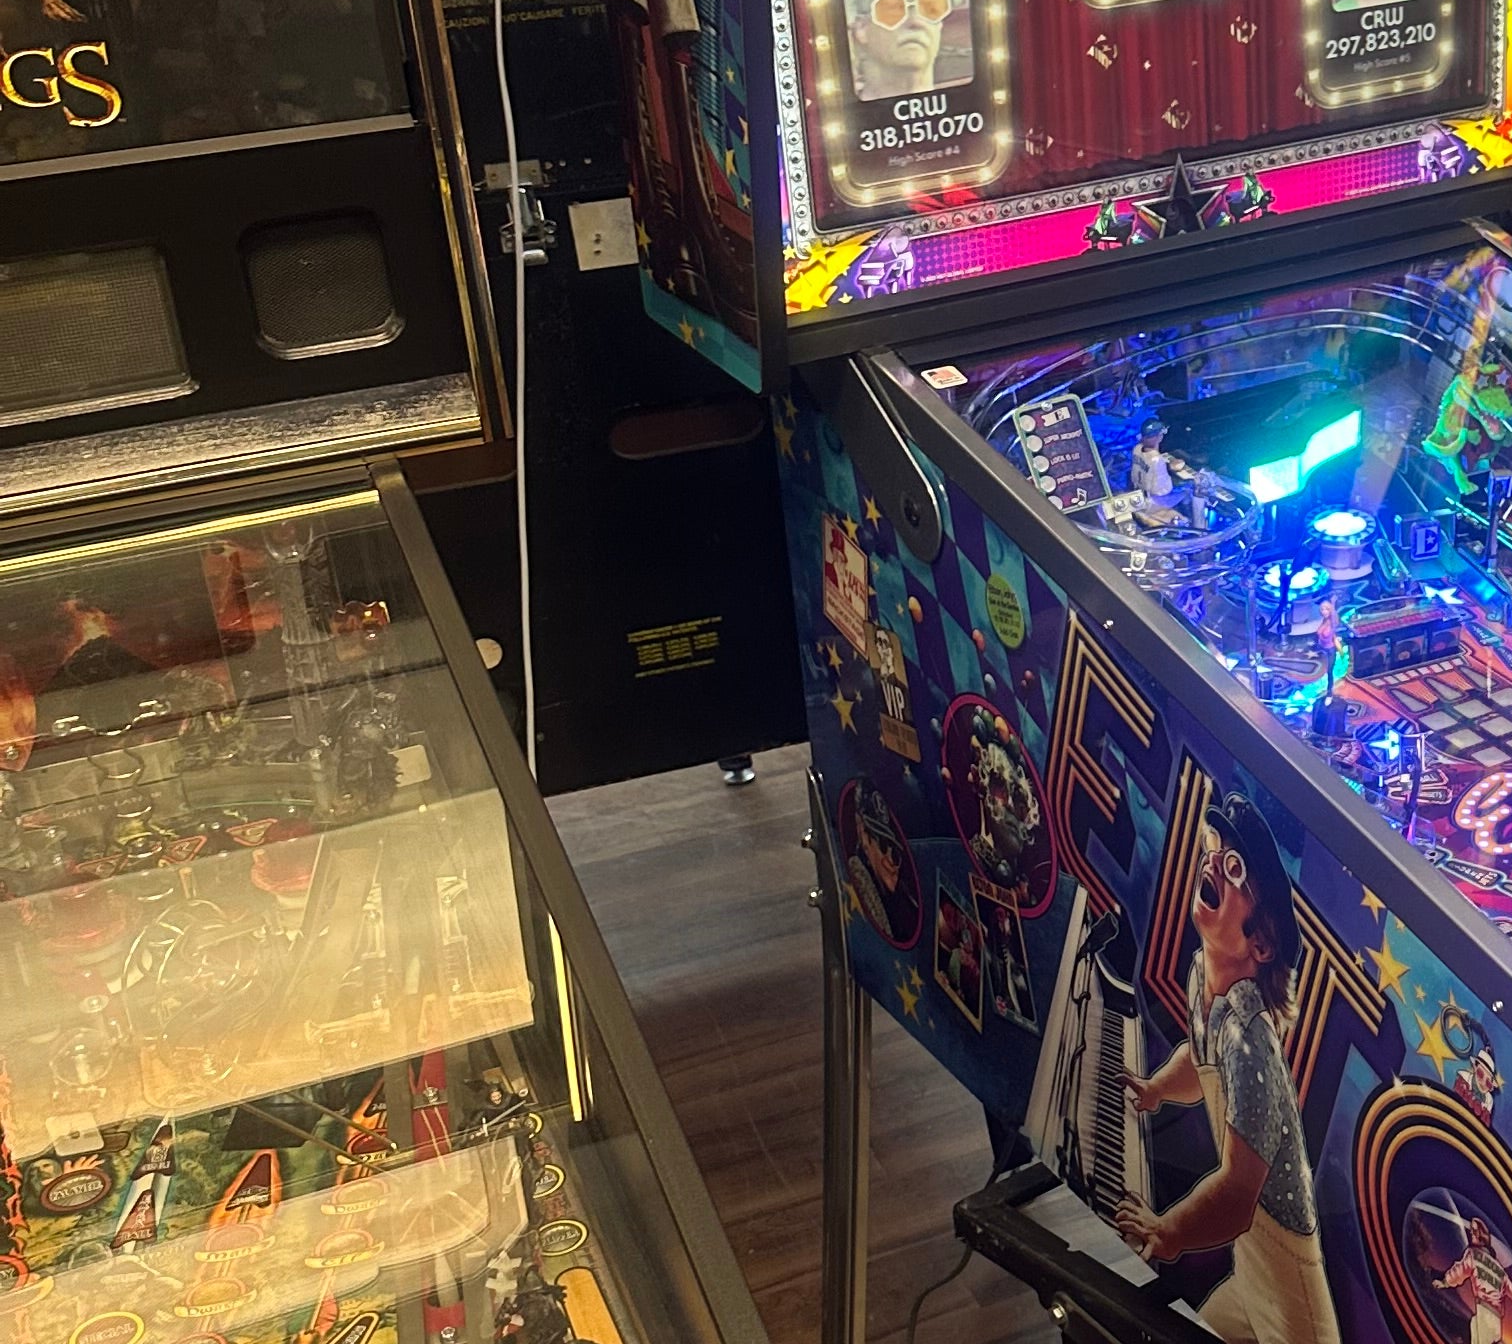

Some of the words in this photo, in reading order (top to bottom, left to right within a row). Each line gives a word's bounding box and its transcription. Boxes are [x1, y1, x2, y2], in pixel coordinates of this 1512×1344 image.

[1360, 5, 1405, 31] CRW
[1325, 22, 1437, 60] 297,823,210
[893, 93, 947, 121] CRW
[859, 112, 984, 152] 318,151,070
[880, 679, 905, 722] VIP
